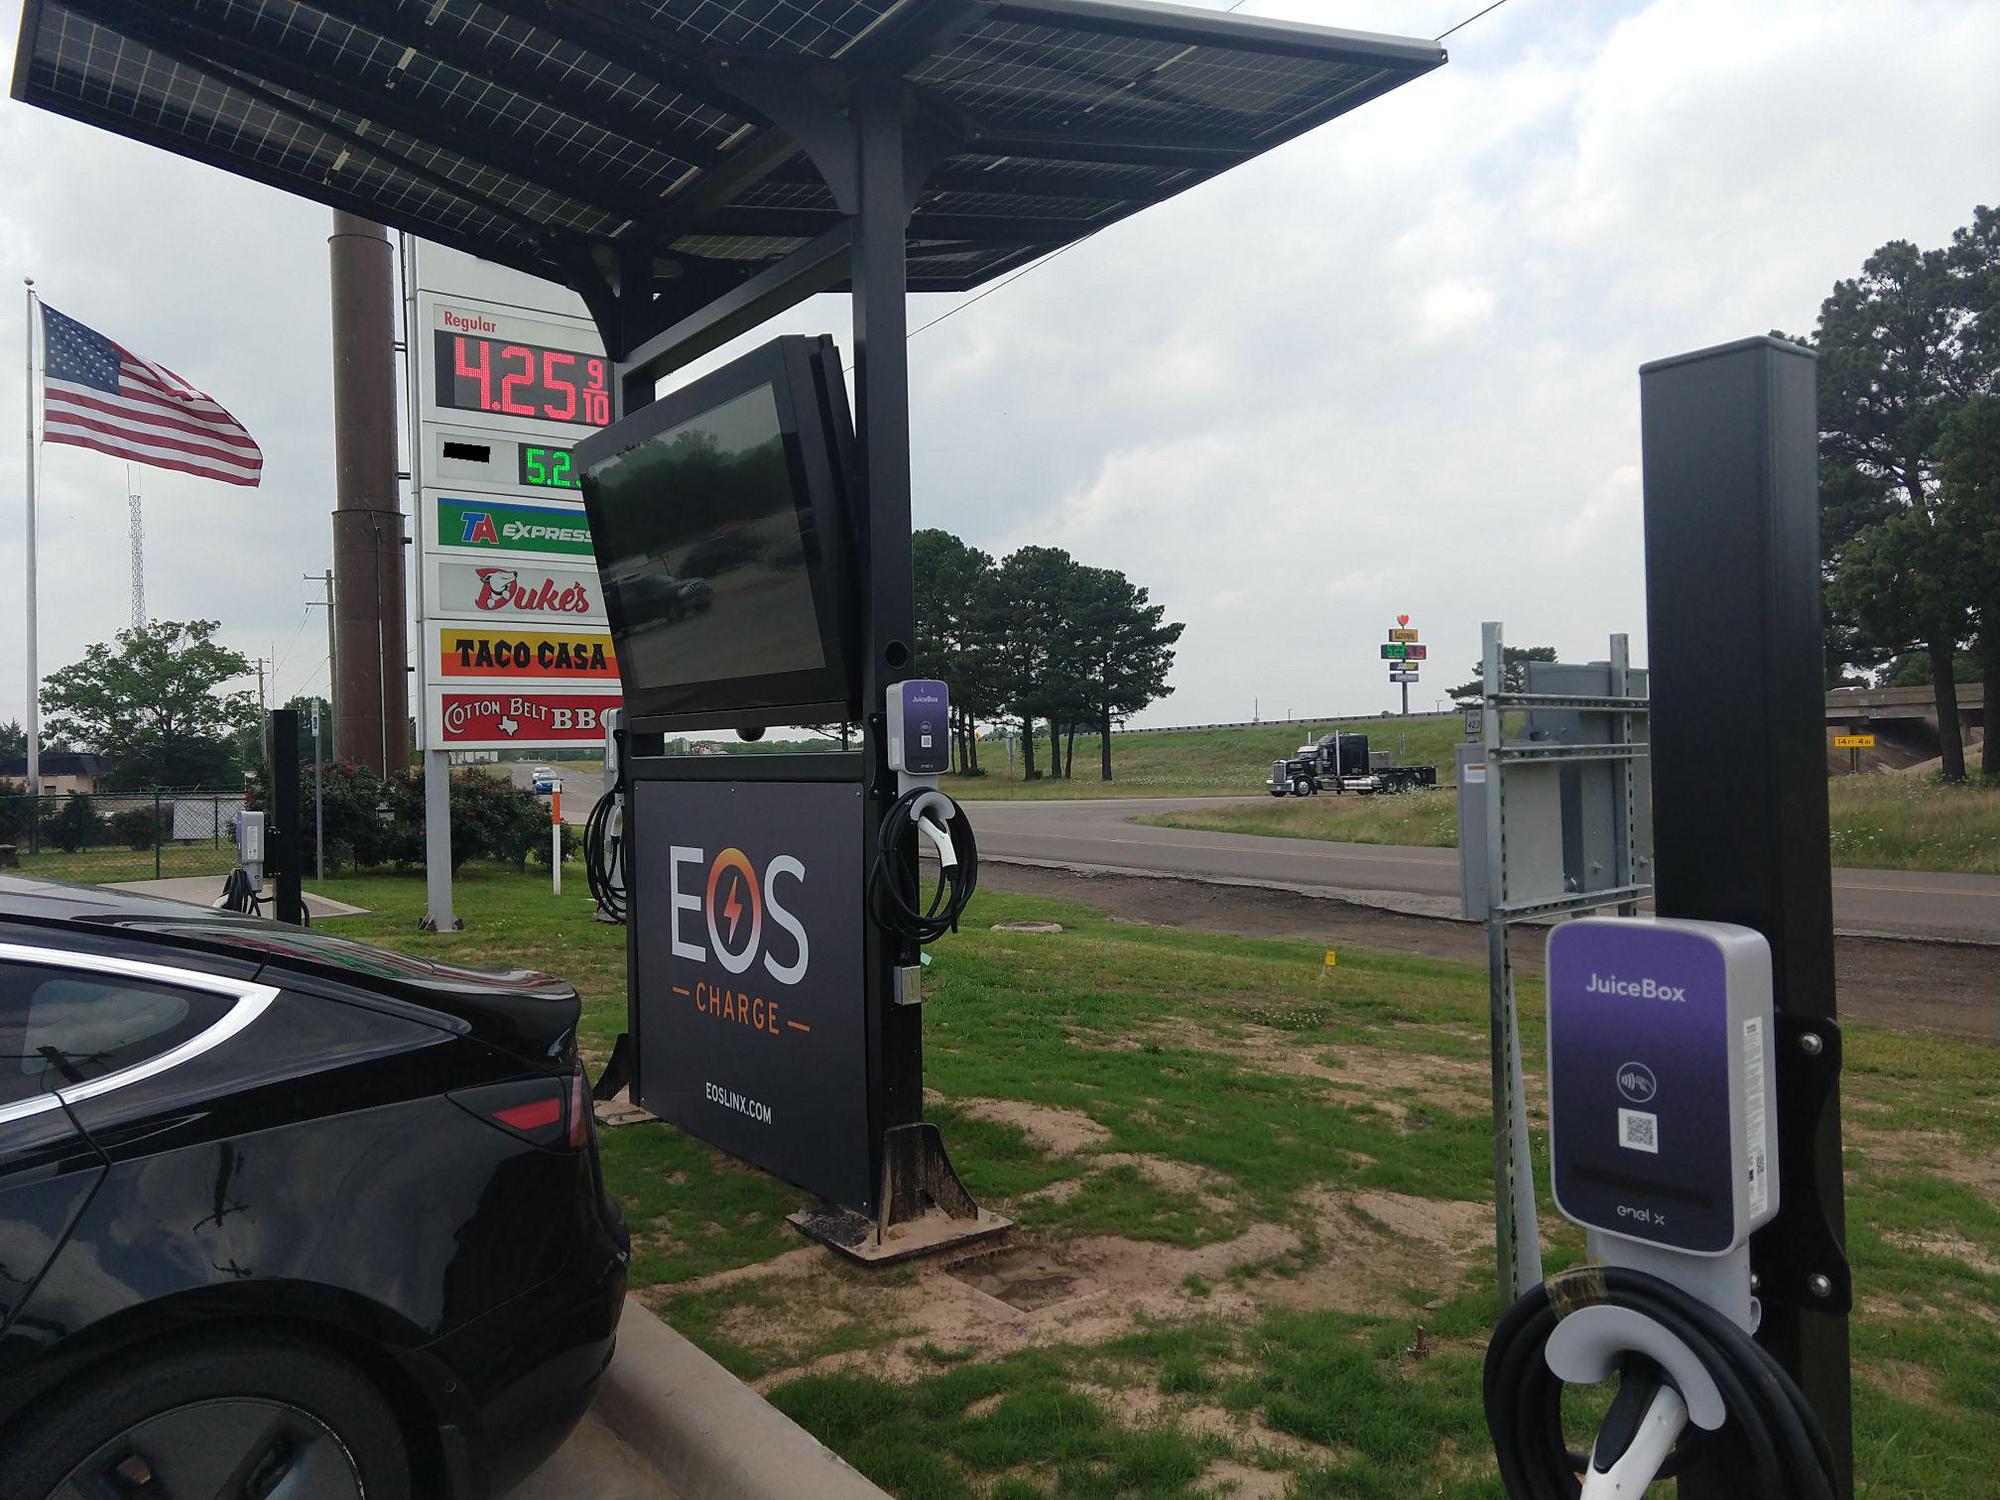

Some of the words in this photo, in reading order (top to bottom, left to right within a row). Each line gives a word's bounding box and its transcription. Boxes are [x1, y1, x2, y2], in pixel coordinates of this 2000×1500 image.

[444, 311, 497, 332] Regular
[454, 337, 576, 421] 4.25
[587, 359, 603, 390] 9
[527, 447, 582, 488] 5.2
[461, 511, 499, 544] TA
[475, 568, 590, 613] Duke's
[455, 639, 530, 669] TACO
[537, 640, 607, 670] CASA
[444, 701, 500, 734] COTTON
[509, 698, 548, 721] BELT
[669, 845, 809, 985] EOS
[1585, 972, 1686, 1002] JuiceBox
[695, 982, 780, 1035] CHARGE
[706, 1081, 772, 1125] EOSLINX.COM
[1616, 1204, 1650, 1223] enel
